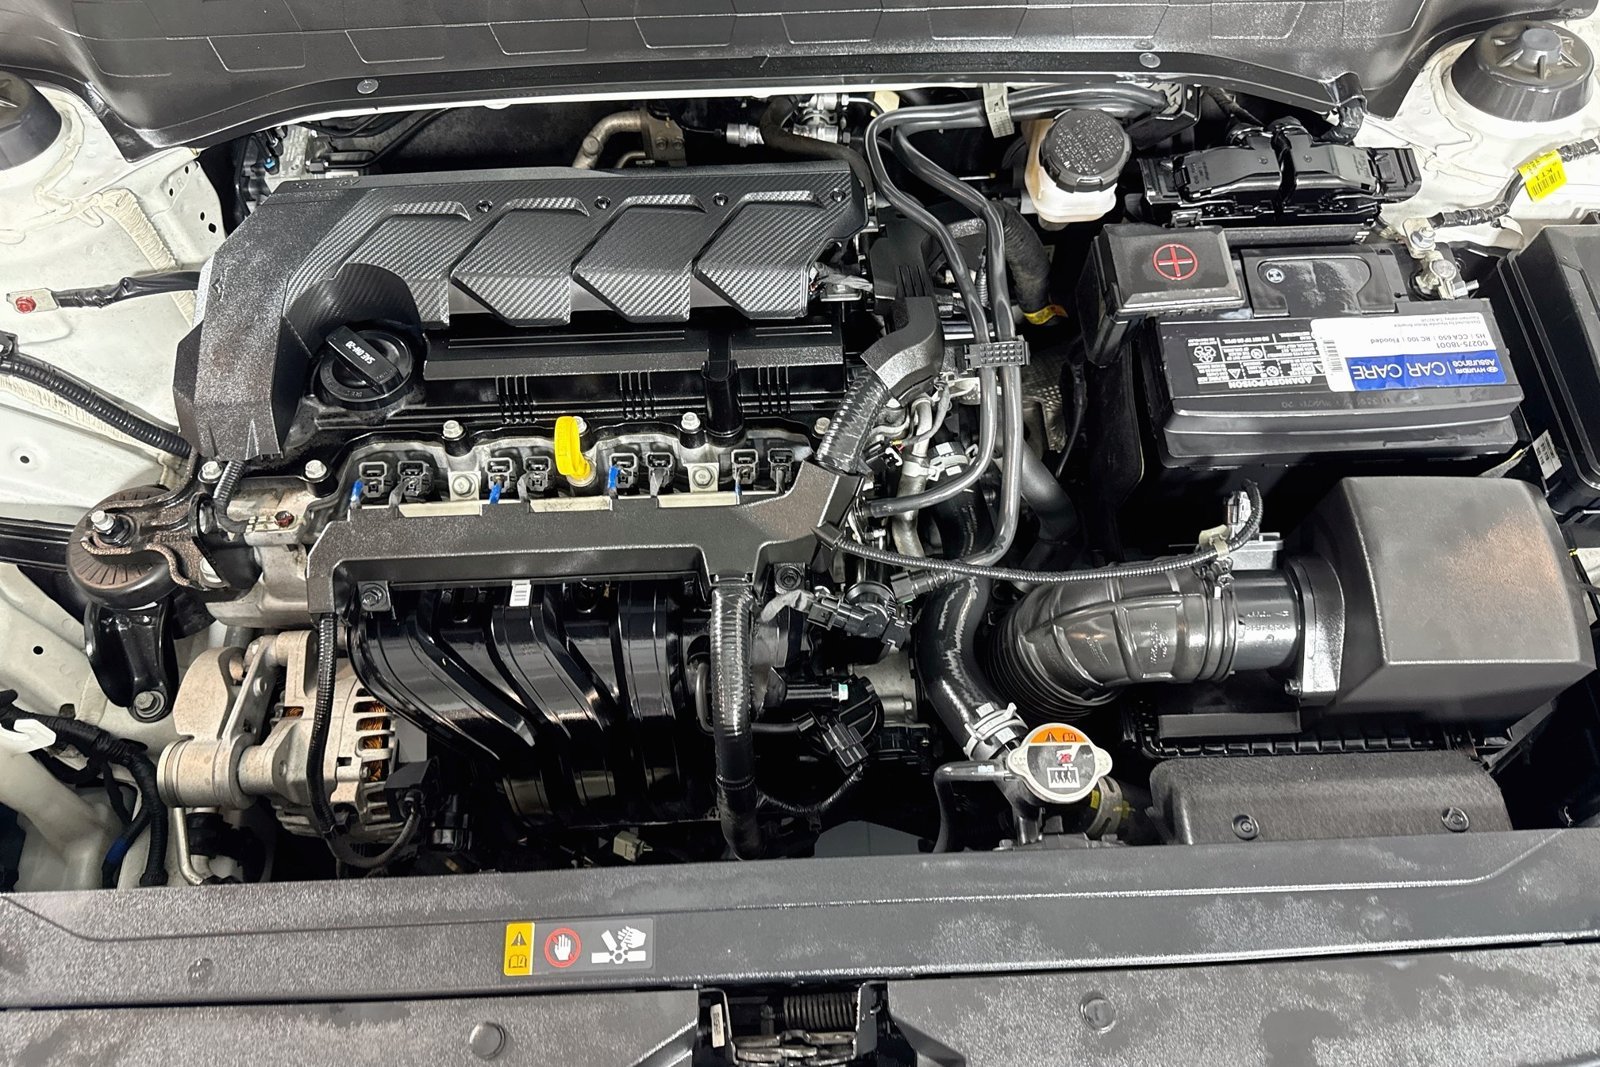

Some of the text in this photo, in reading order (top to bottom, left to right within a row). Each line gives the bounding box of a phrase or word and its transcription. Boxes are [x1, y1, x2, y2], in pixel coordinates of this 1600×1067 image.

[1436, 340, 1488, 349] 00275-18001
[360, 352, 375, 364] SAE
[1452, 359, 1495, 367] Assurance
[1351, 361, 1446, 379] CAR CARE
